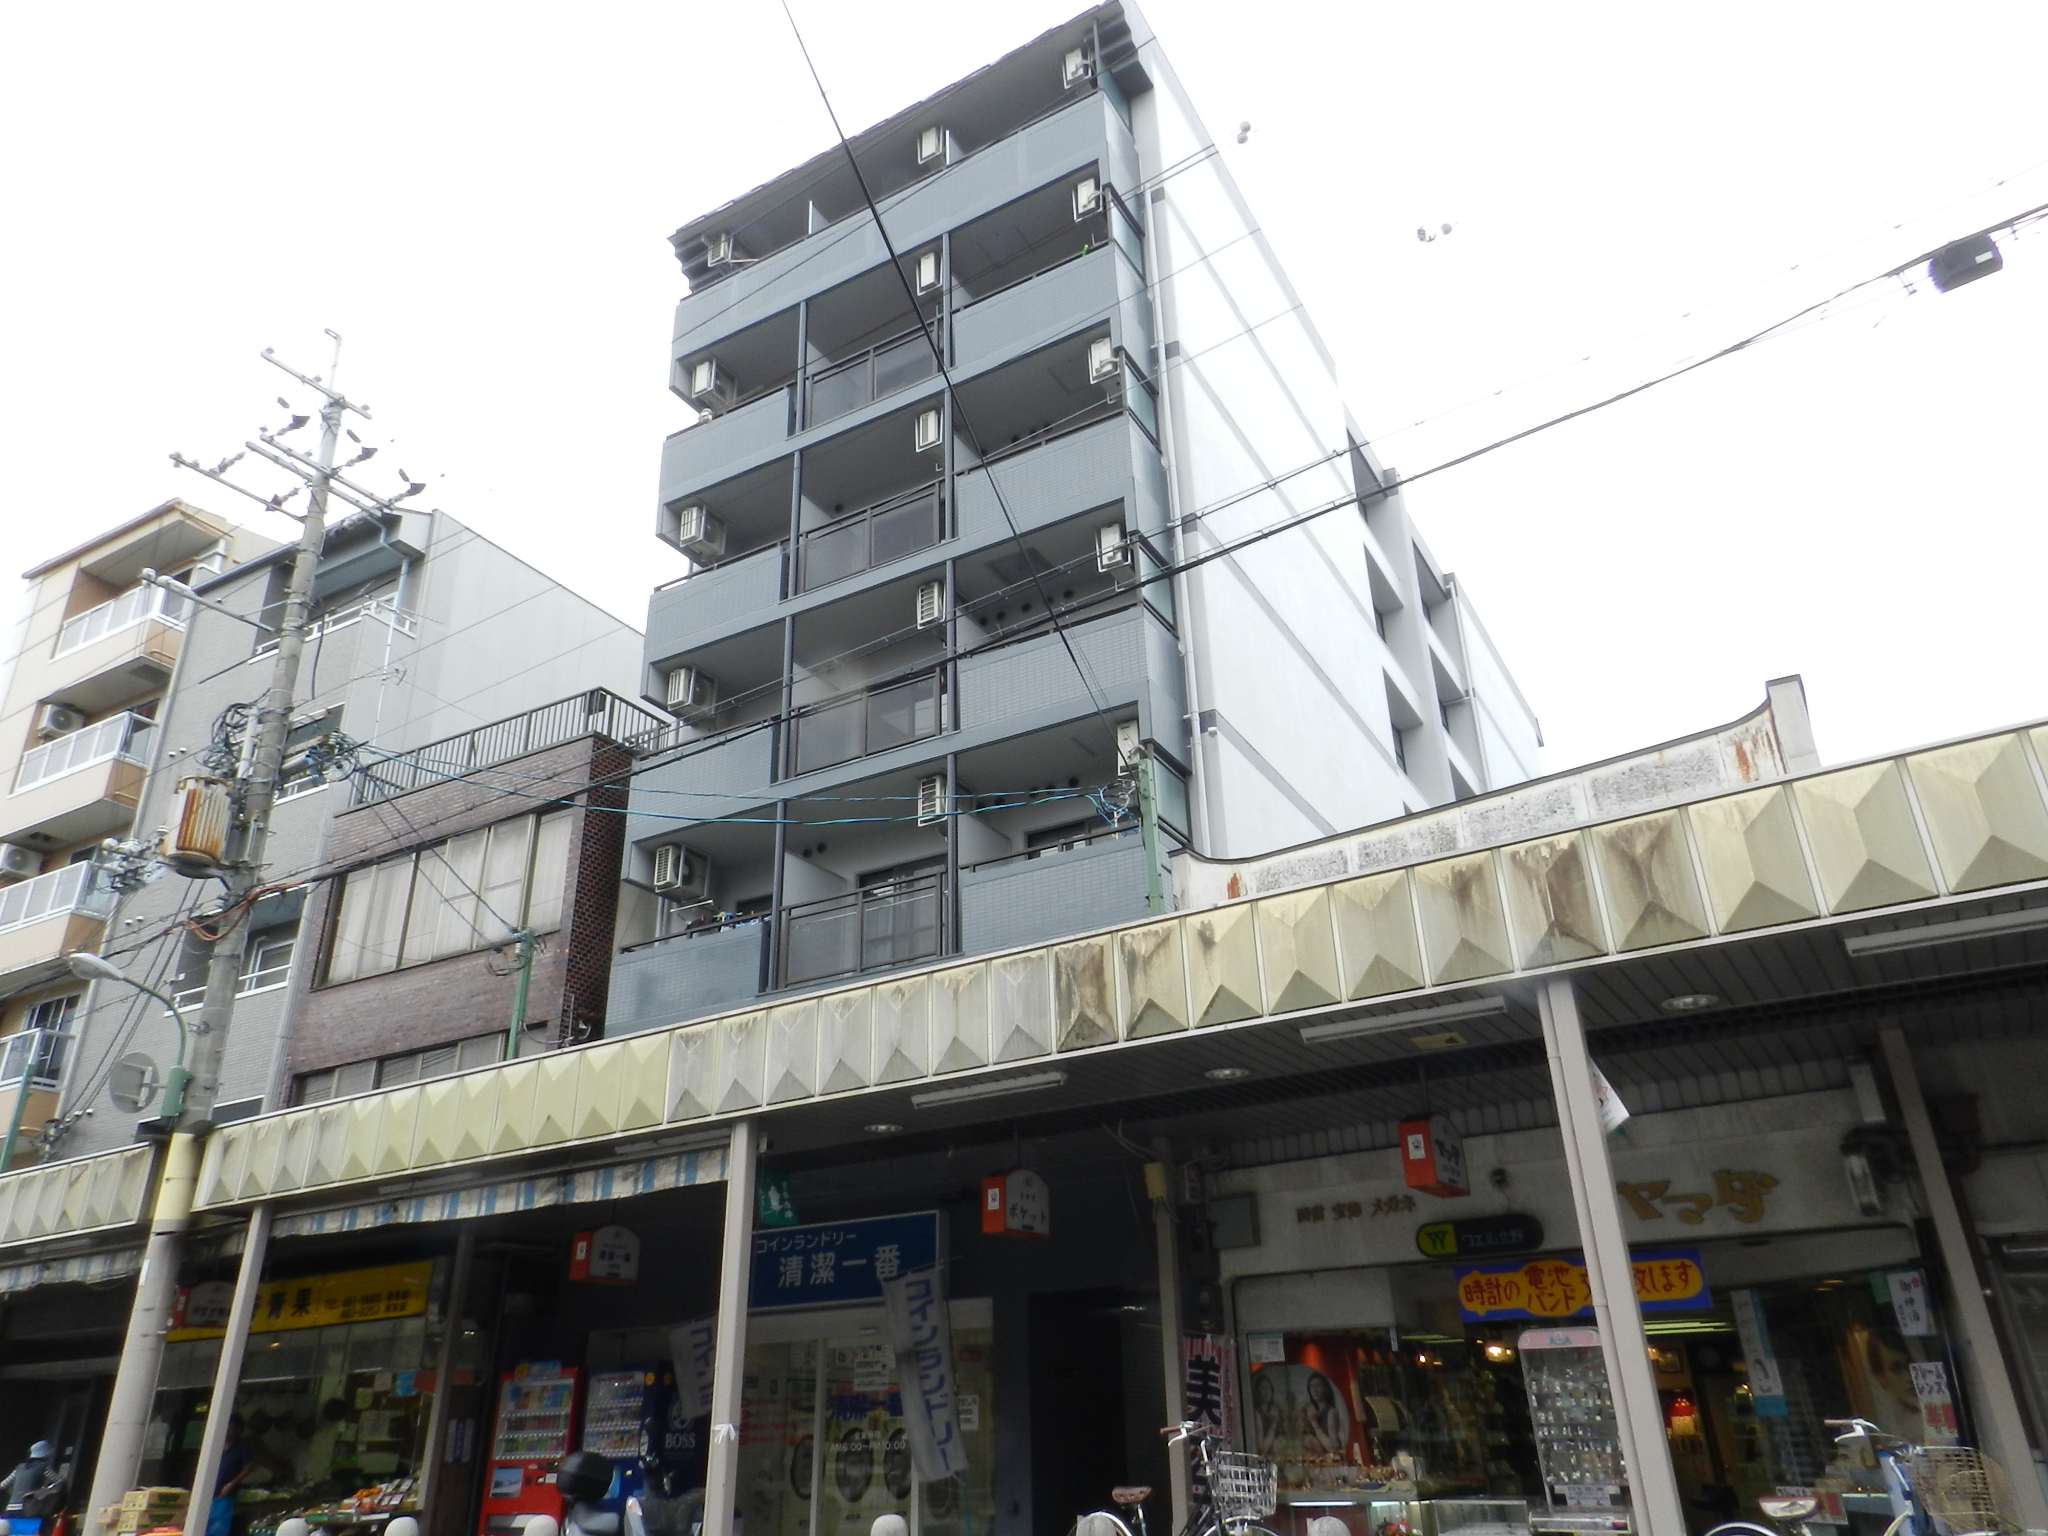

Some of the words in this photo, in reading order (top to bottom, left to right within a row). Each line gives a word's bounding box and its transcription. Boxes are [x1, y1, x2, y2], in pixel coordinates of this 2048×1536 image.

[756, 1231, 857, 1254] コインランドリー
[778, 1244, 901, 1288] 清潔一番
[1524, 1264, 1572, 1290] 電池
[252, 1287, 312, 1322] 青果
[1463, 1278, 1520, 1306] 時計の
[1527, 1286, 1576, 1312] バンド
[905, 1278, 953, 1471] コインランドリー
[665, 1432, 696, 1449] BOSS
